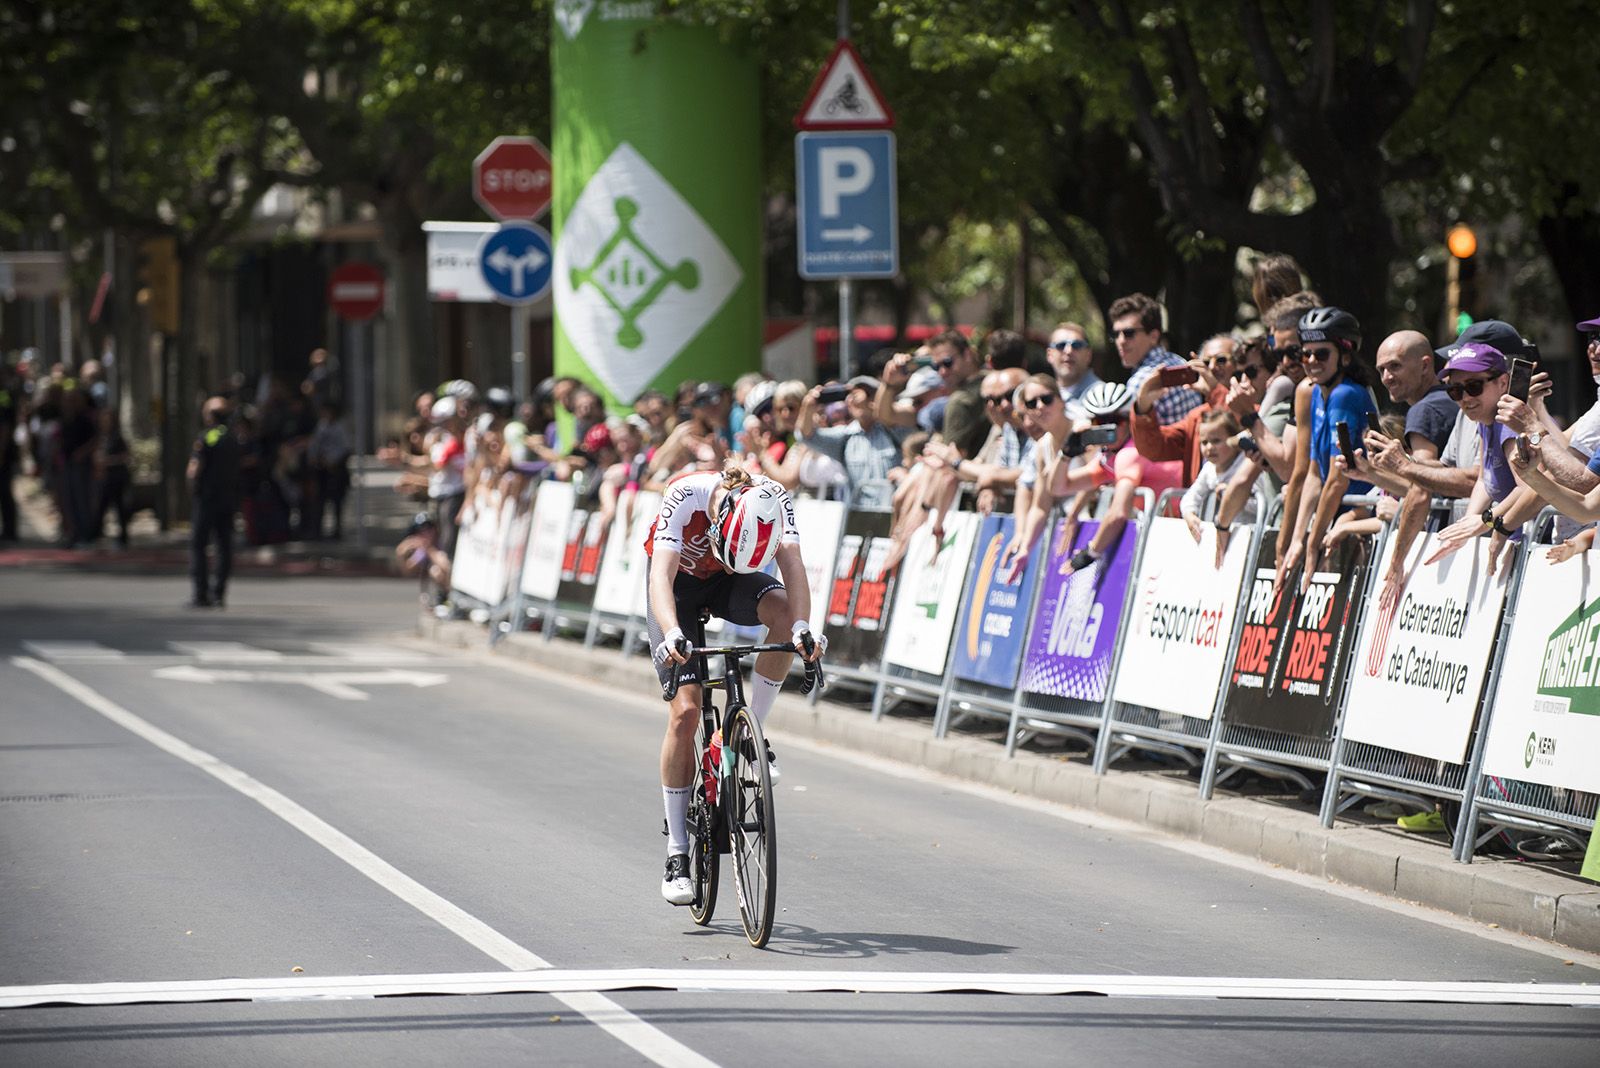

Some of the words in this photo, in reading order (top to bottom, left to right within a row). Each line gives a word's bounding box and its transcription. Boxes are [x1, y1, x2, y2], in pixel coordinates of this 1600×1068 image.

[484, 168, 550, 193] STOP
[818, 147, 875, 217] P
[1150, 599, 1224, 654] esportcat
[1246, 580, 1282, 625] PRO
[1297, 584, 1335, 631] PRO
[1400, 592, 1468, 639] Generalitat
[1236, 624, 1279, 674] RIDE
[1285, 629, 1332, 681] RIDE
[1388, 644, 1403, 682] de
[1404, 646, 1468, 704] Catalunya
[1537, 736, 1557, 756] KERN
